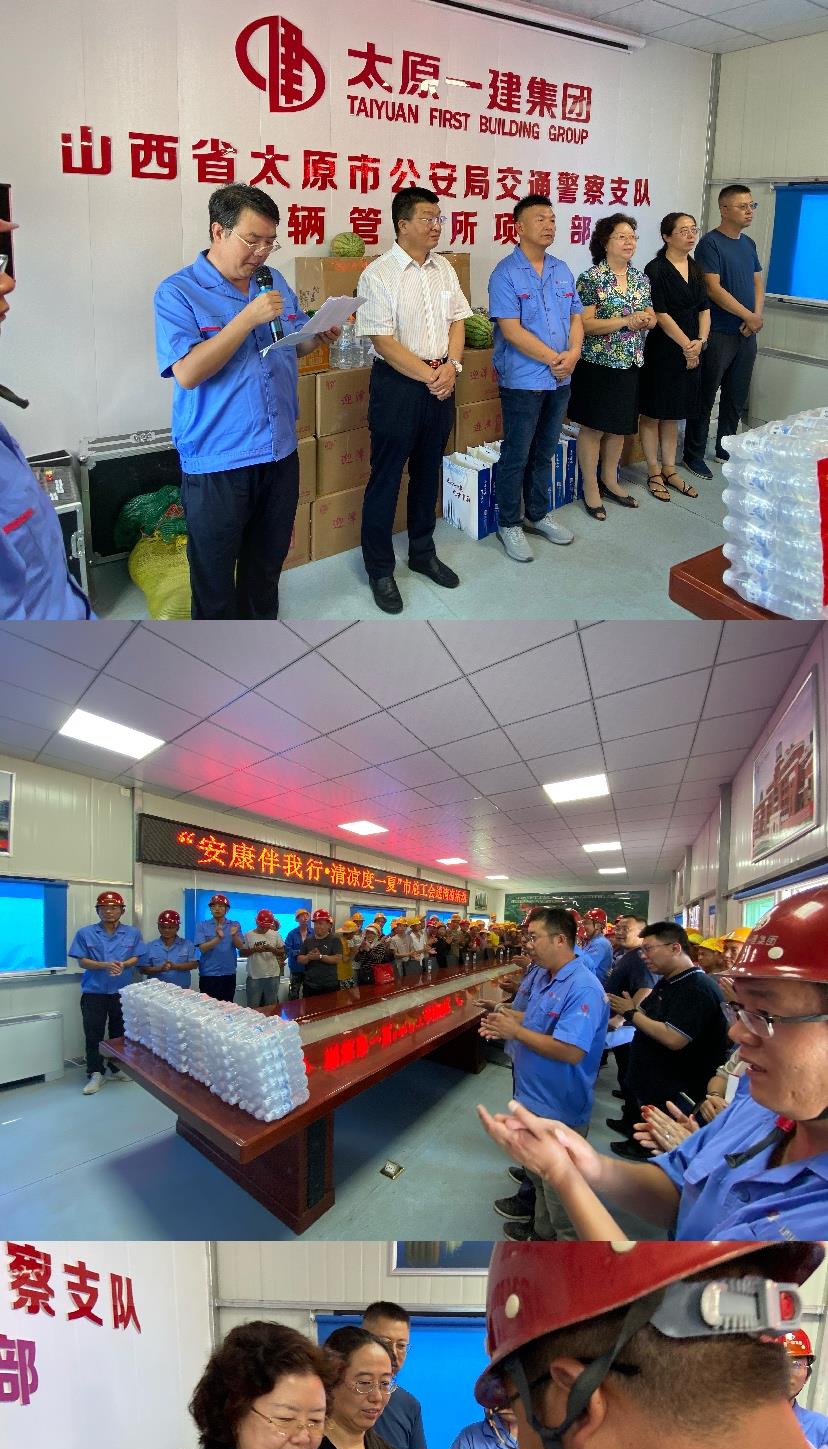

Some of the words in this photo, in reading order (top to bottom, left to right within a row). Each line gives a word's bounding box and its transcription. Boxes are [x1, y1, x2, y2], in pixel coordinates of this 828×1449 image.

[346, 94, 419, 125] TAIYUAN
[429, 106, 471, 132] FIRST
[479, 114, 540, 141] BUILDING
[549, 124, 590, 146] GROUP
[347, 41, 593, 124] 太原一建集团
[60, 125, 653, 208] 山西省太原市公安局交通警察支队
[7, 1243, 142, 1334] 察支队
